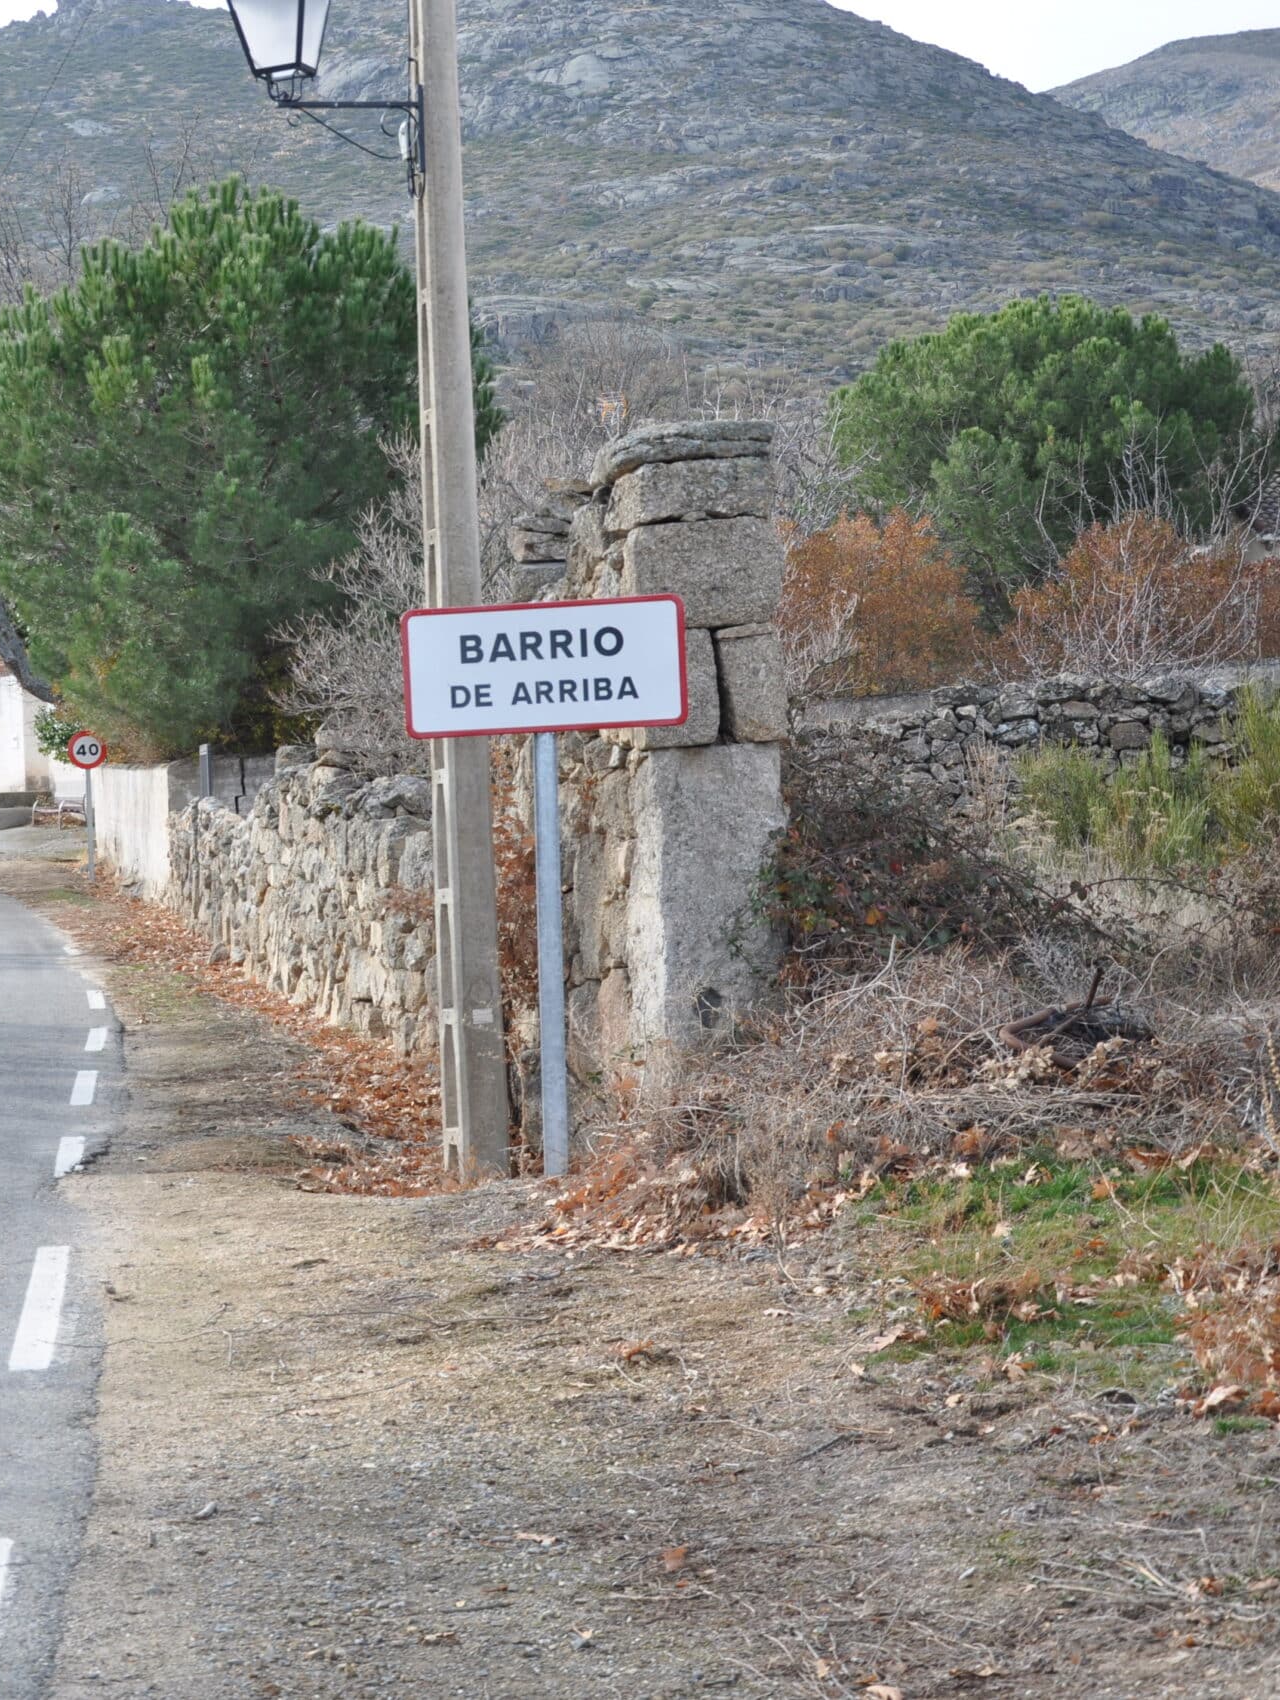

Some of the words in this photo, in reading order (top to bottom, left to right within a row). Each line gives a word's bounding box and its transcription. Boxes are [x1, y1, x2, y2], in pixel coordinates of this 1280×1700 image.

[459, 626, 624, 664] BARRIO
[450, 683, 493, 709] DE
[511, 676, 639, 705] ARRIBA
[76, 743, 99, 756] 40
